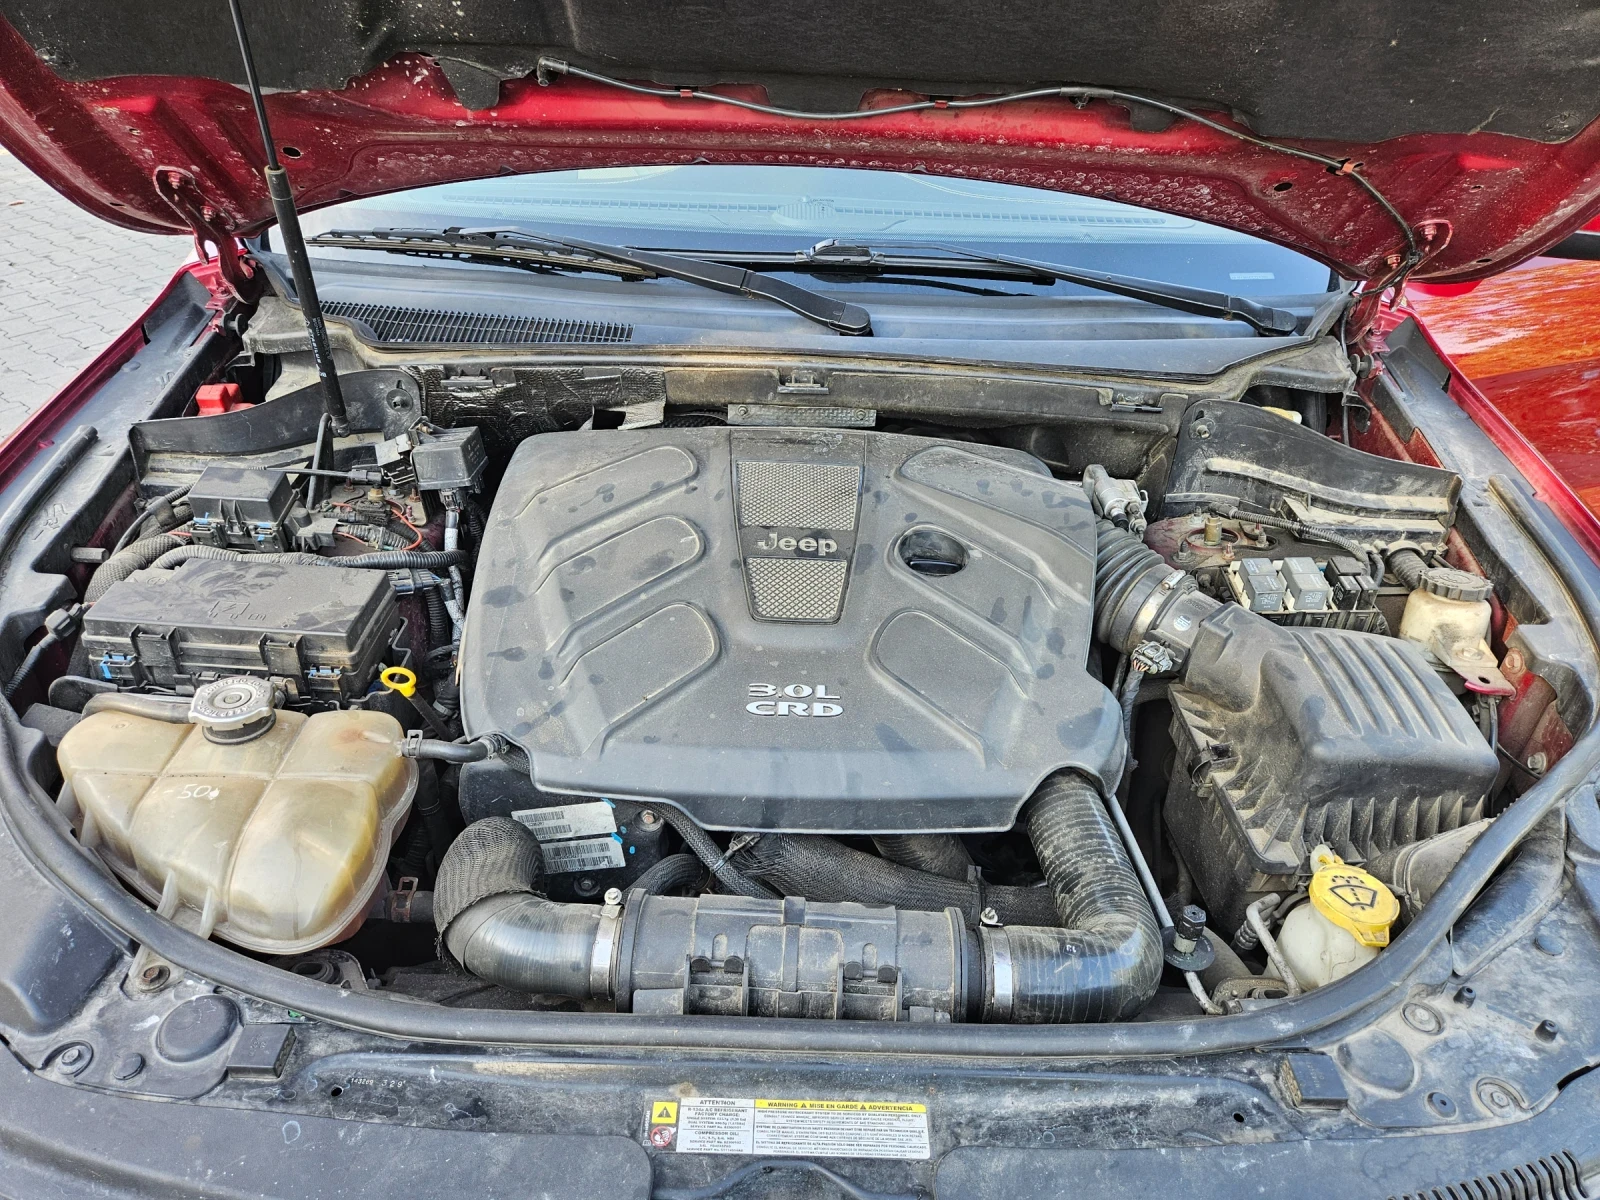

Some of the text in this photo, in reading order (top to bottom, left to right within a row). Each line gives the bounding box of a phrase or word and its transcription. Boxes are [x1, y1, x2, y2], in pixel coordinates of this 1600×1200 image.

[757, 532, 838, 556] Jeep
[748, 682, 841, 700] 3.0L
[746, 701, 844, 718] CRD
